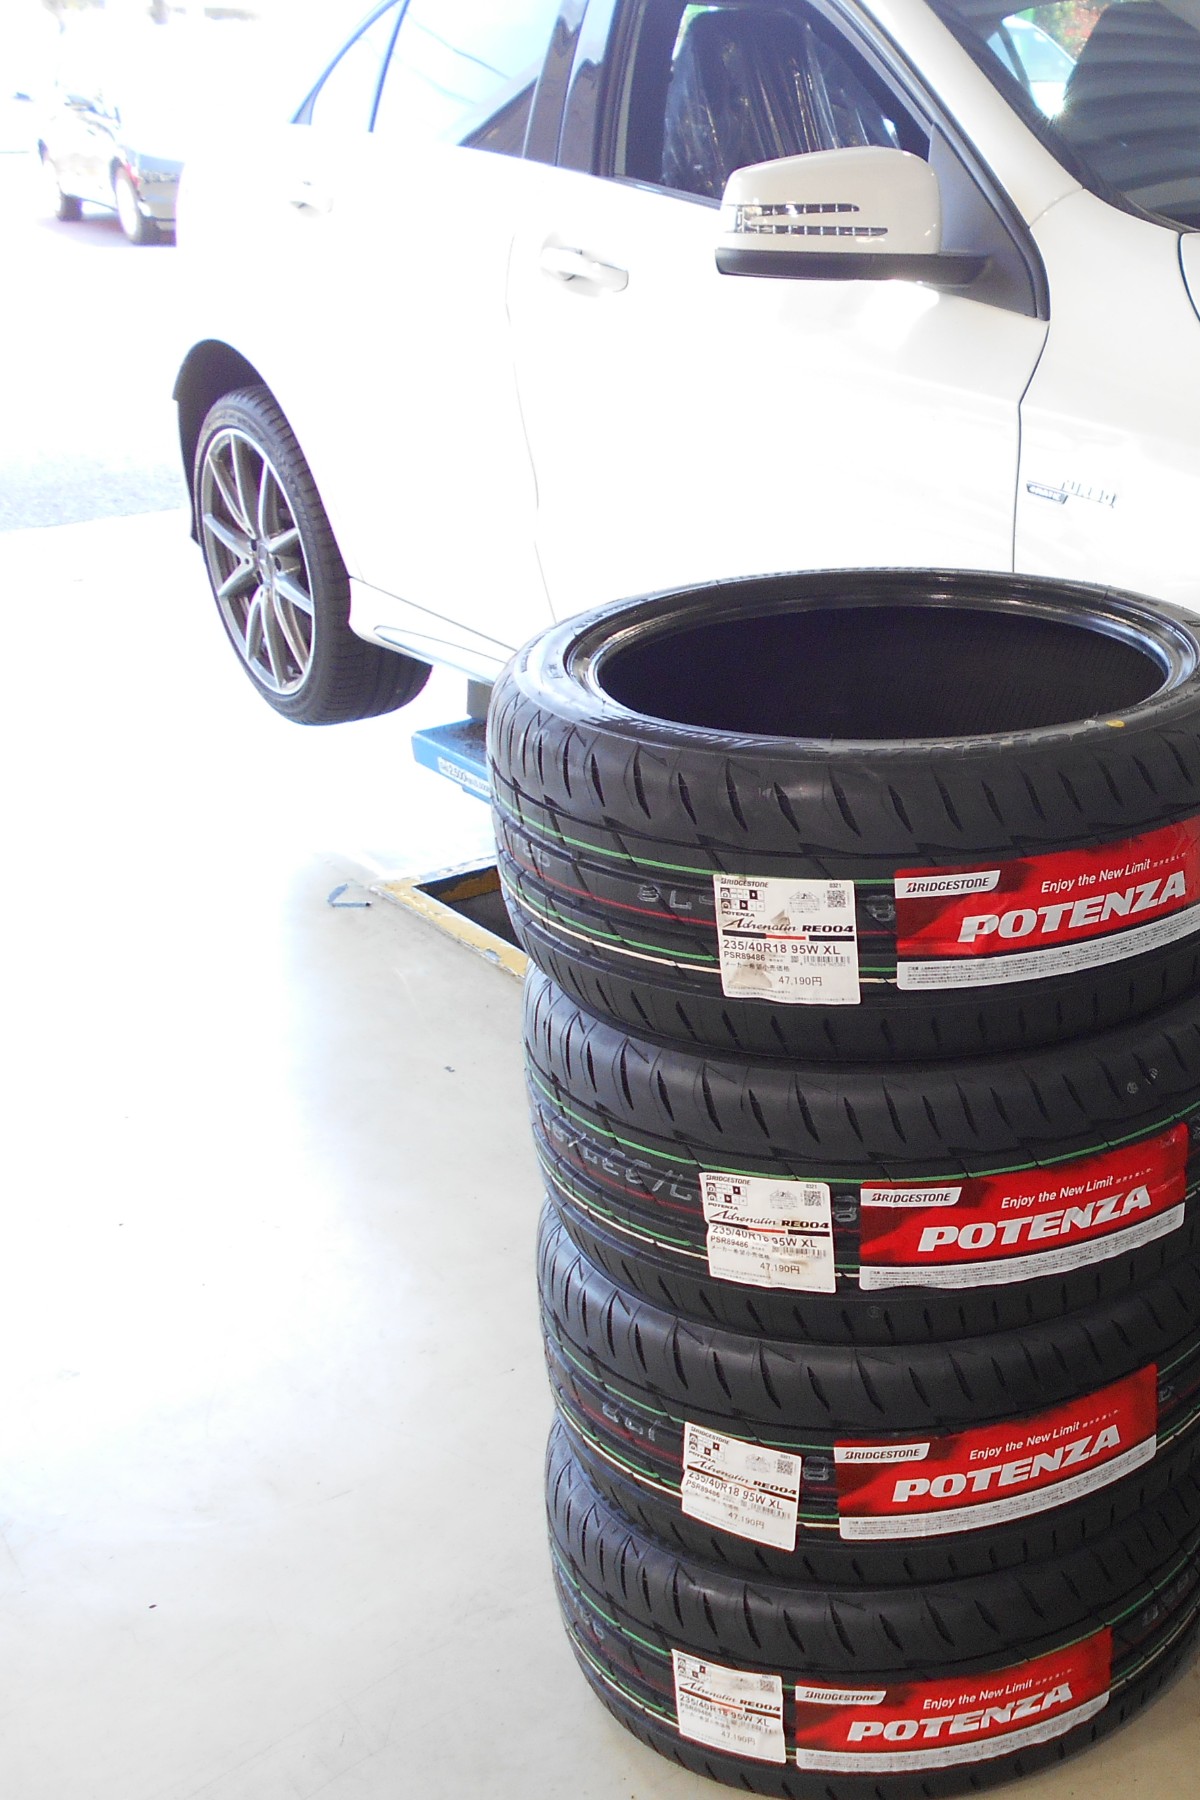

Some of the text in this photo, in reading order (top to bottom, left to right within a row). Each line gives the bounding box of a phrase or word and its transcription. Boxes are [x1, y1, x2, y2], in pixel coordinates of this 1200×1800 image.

[720, 878, 769, 888] BRIDGESTONE
[1041, 880, 1075, 893] Enjoy
[1078, 874, 1096, 886] the
[1099, 868, 1123, 882] New
[1125, 859, 1150, 876] Limit
[906, 877, 989, 893] BRIDGESTONE
[957, 871, 1186, 943] POTENZA
[723, 918, 854, 933] Adrenalin RE004
[723, 940, 840, 955] 235/40R18 95W XL
[723, 951, 766, 961] PSR89486
[706, 1175, 751, 1185] BRIDGESTONE
[871, 1192, 951, 1203] BRIDGESTONE
[1001, 1195, 1035, 1209] Enjoy
[1038, 1191, 1056, 1202] the
[1059, 1184, 1084, 1199] New
[1086, 1175, 1113, 1192] Limit
[710, 1210, 829, 1228] Adrenalin RE004
[917, 1184, 1151, 1252] POTENZA
[771, 1237, 797, 1246] 95W
[801, 1239, 817, 1248] XL
[969, 1421, 1080, 1460] Enjoy the New Limit
[845, 1448, 920, 1459] BRIDGESTONE
[892, 1424, 1120, 1502] POTENZA
[753, 1480, 797, 1495] RE004
[742, 1491, 766, 1505] 95W
[769, 1498, 783, 1509] XL
[805, 1690, 877, 1701] BRIDGESTONE
[923, 1678, 1032, 1710] Enjoy the New Limit
[739, 1699, 781, 1711] RE004
[847, 1682, 1073, 1742] POTENZA
[730, 1712, 753, 1722] 95W
[757, 1716, 770, 1727] XL
